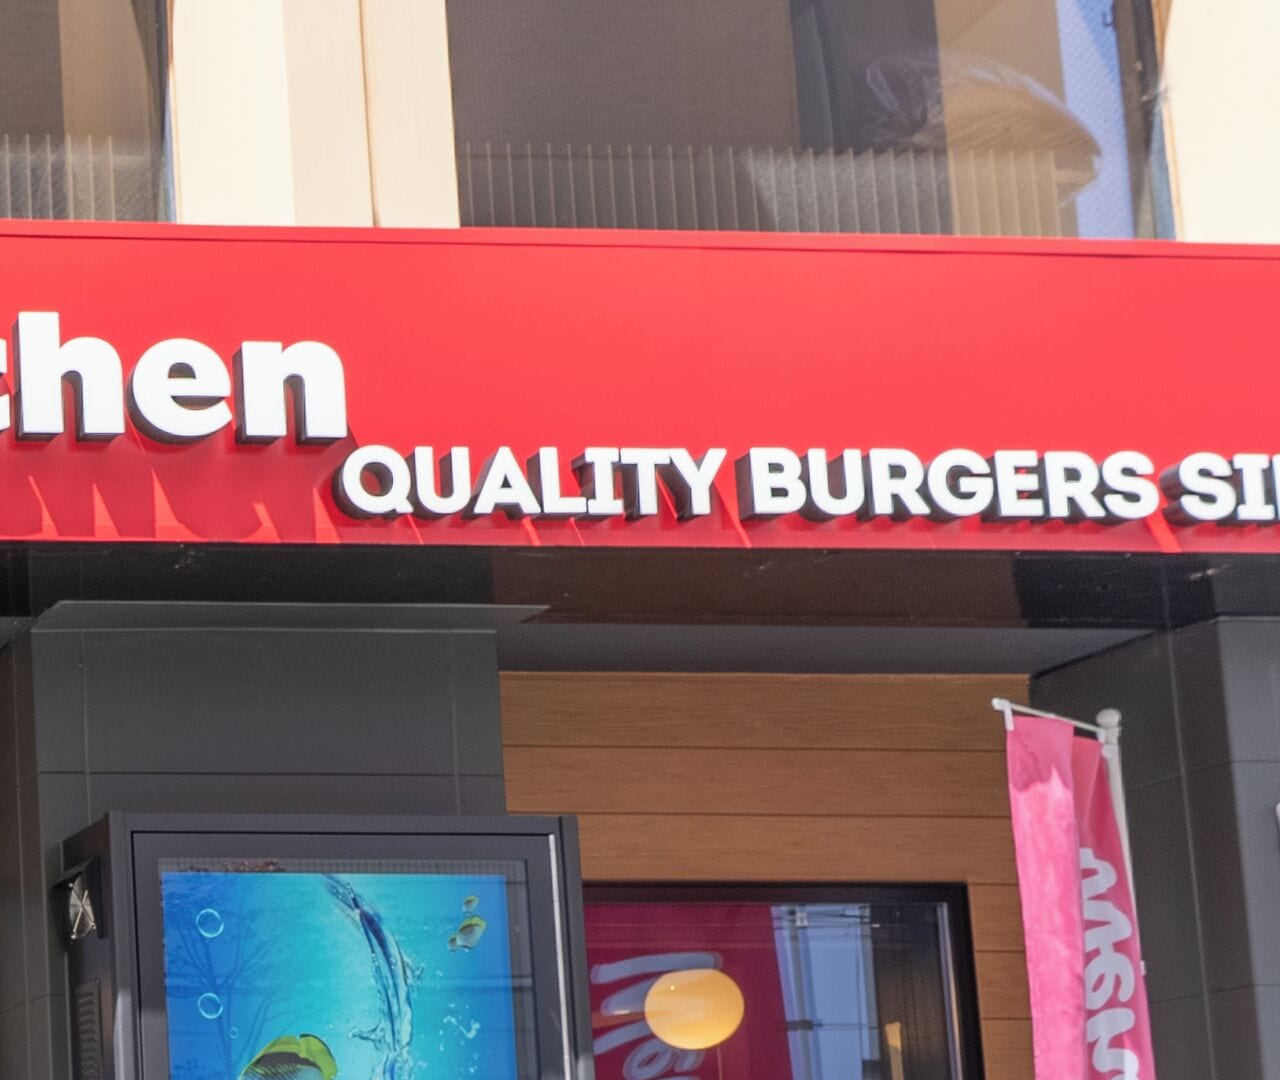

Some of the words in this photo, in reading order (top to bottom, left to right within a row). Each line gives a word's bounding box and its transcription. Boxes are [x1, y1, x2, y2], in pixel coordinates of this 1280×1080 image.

[341, 444, 727, 517] QUALITY
[751, 447, 1160, 519] BURGERS
[1178, 451, 1280, 521] SI
